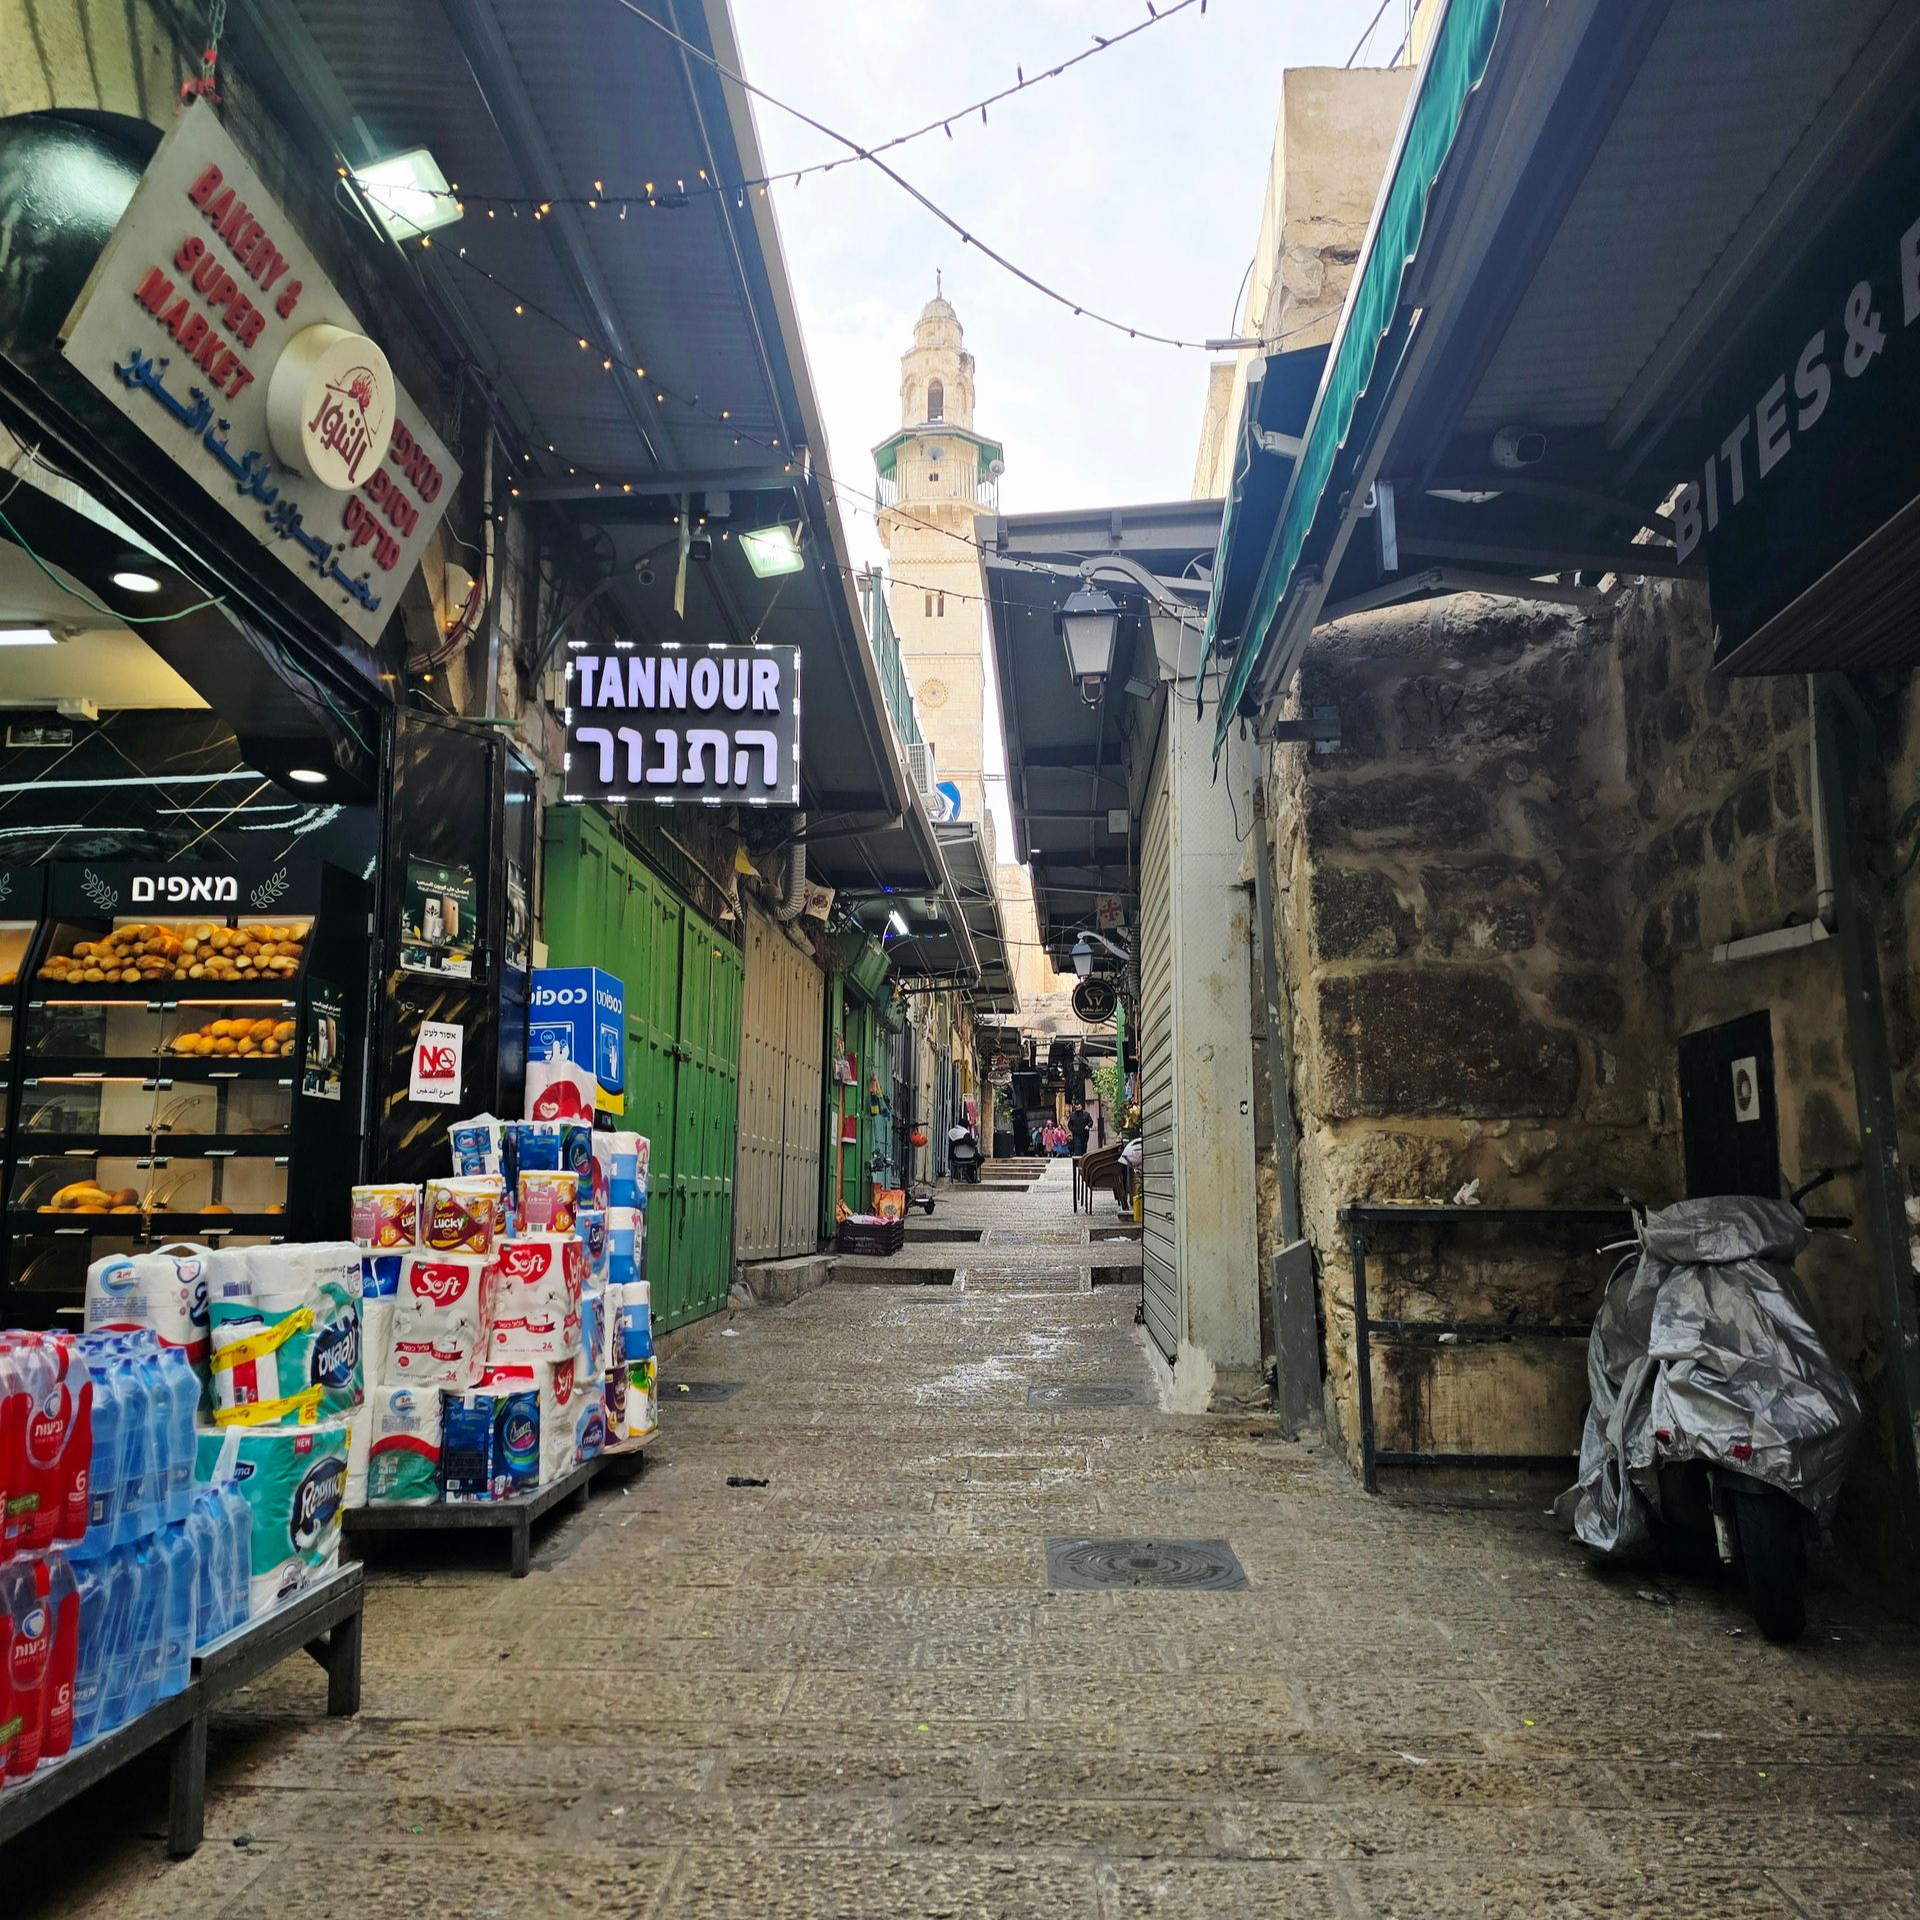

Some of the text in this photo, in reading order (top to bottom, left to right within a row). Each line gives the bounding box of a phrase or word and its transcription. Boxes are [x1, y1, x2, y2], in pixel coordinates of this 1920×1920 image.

[188, 164, 303, 319] BAKERY &
[174, 234, 266, 349] SUPER
[134, 265, 255, 398] MARKET
[114, 346, 216, 435] التنور
[1675, 280, 1887, 565] BITES &
[362, 467, 420, 538] וסופ
[343, 494, 400, 571] מרקט
[575, 656, 781, 712] TANNOUR
[575, 726, 778, 786] התנור
[131, 876, 239, 902] מאפים
[531, 986, 588, 1006] כספו
[441, 1029, 456, 1039] אסור
[419, 1044, 457, 1072] NO
[505, 1250, 546, 1277] Soft
[416, 1270, 462, 1299] Soft
[34, 1419, 64, 1437] נביעות
[296, 1436, 311, 1448] NEW
[76, 1470, 86, 1492] 6
[58, 1683, 70, 1704] 6
